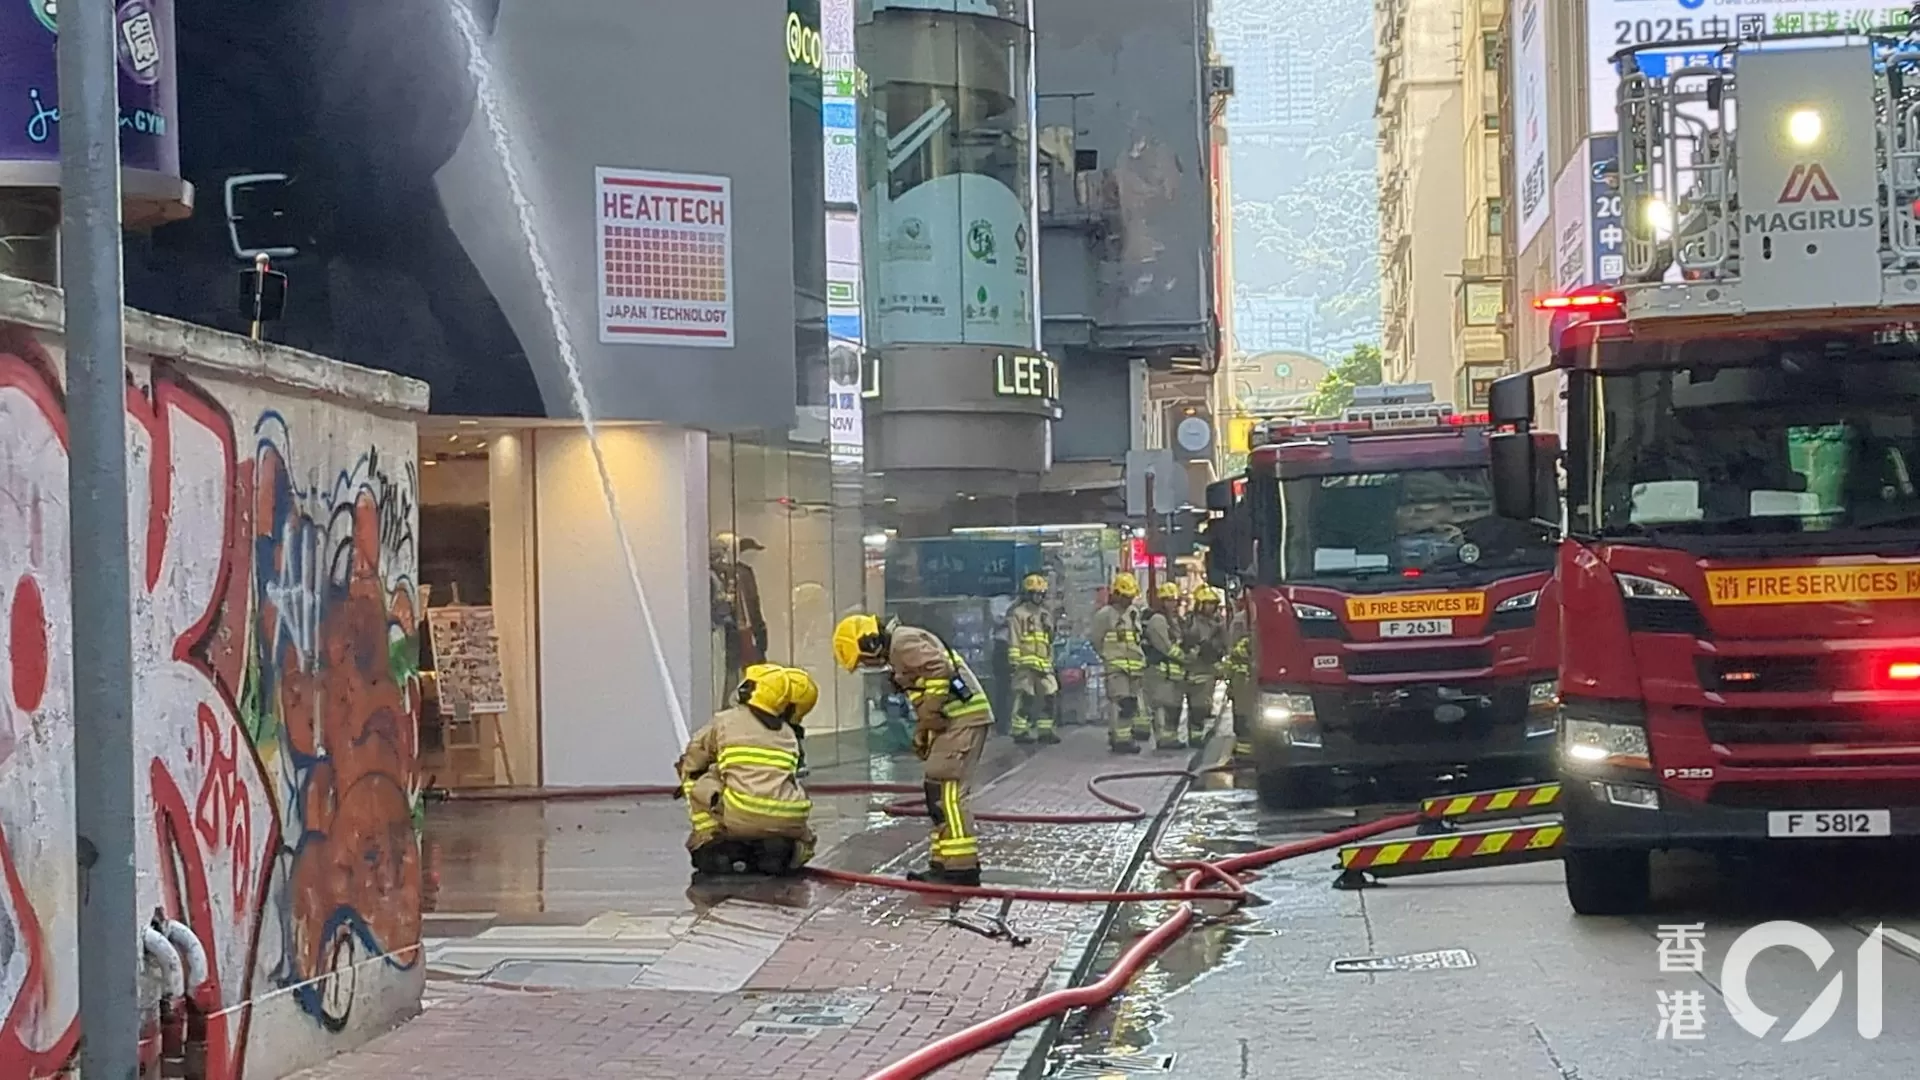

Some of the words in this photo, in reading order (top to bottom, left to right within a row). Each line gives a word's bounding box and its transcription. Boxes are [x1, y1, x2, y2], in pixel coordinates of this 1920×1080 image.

[134, 109, 166, 136] GYM
[603, 192, 725, 226] HEATTECH
[1744, 207, 1874, 234] MAGIRUS
[606, 304, 647, 319] JAPAN
[652, 306, 727, 323] TECHNOLOGY
[998, 355, 1042, 395] LEE
[1746, 576, 1791, 596] FIRE
[1796, 572, 1898, 595] SERVICES
[1370, 602, 1398, 615] FIRE
[1400, 598, 1461, 613] SERVICES
[1390, 623, 1400, 635] F
[1406, 621, 1442, 635] 2631
[1663, 768, 1676, 779] P
[1677, 768, 1714, 779] 320
[1788, 814, 1803, 833] F
[1815, 813, 1871, 834] 5812
